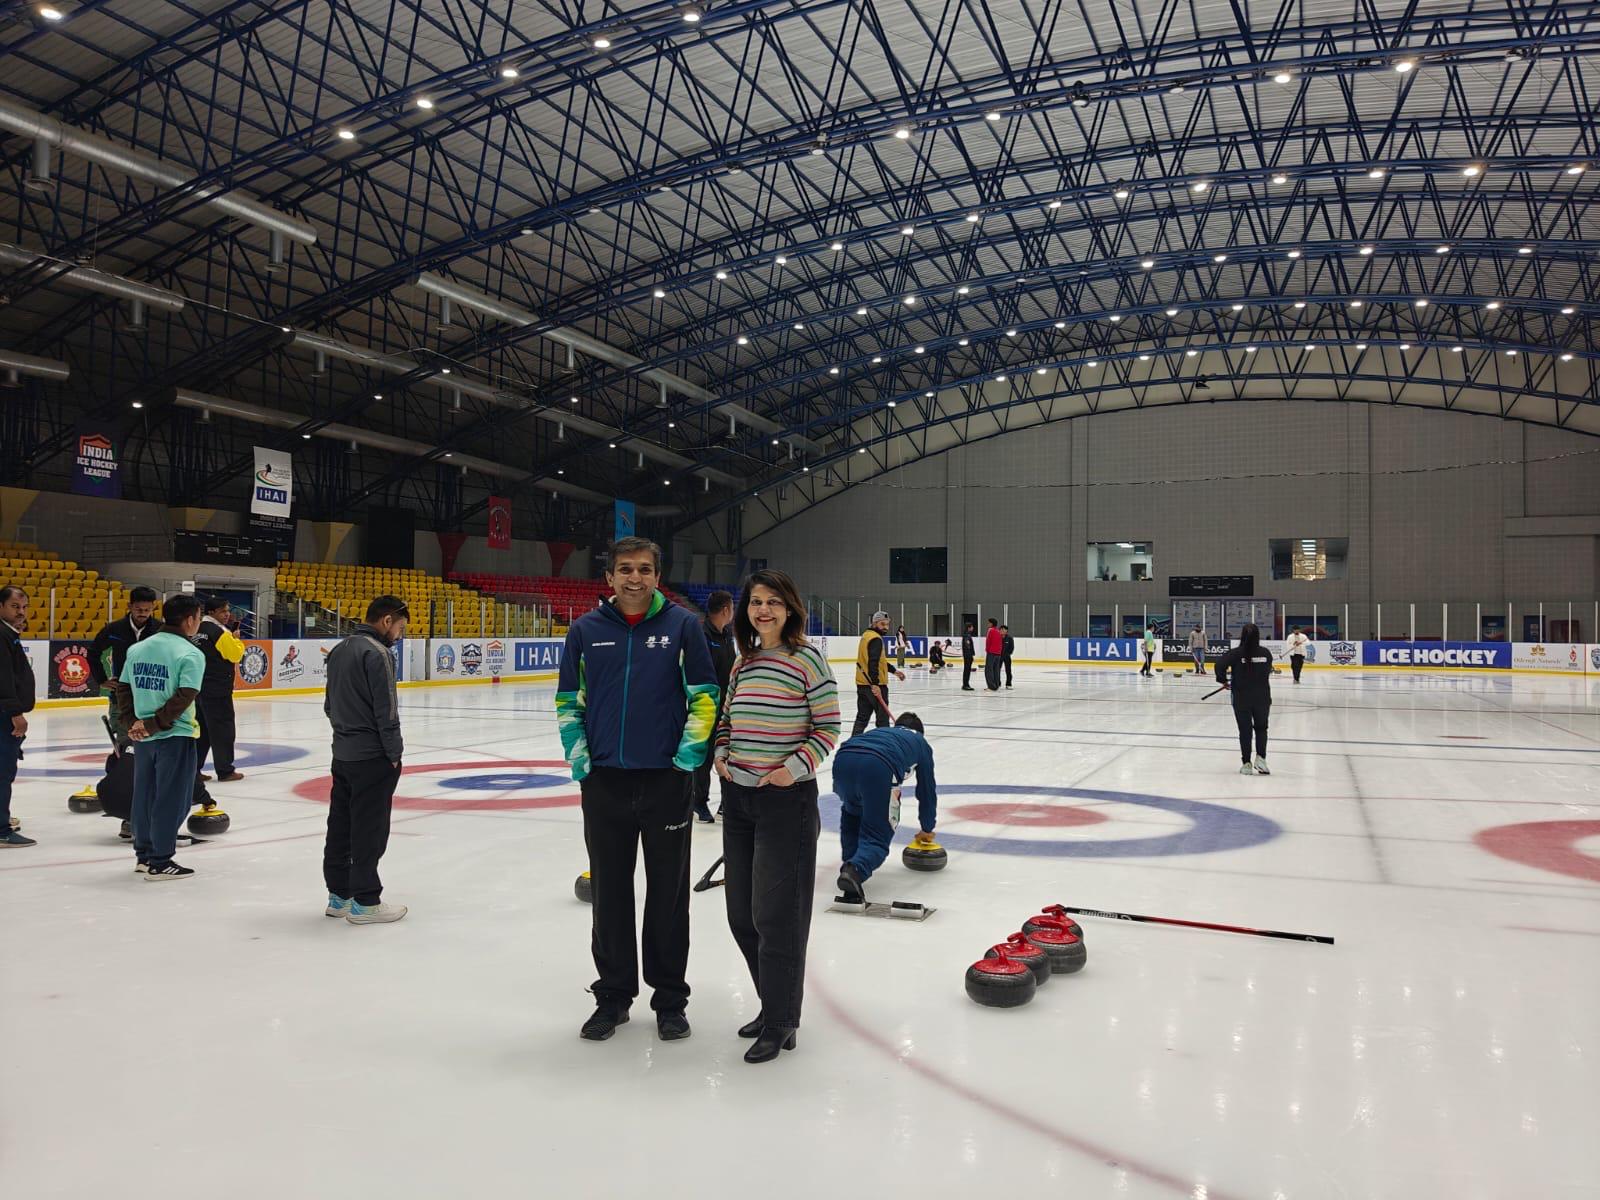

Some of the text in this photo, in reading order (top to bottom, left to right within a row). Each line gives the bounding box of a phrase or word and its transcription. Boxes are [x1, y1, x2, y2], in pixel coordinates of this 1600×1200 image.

[83, 445, 113, 460] INDIA
[77, 456, 118, 470] ICE HOCKEY
[84, 467, 111, 478] LEAGUE
[260, 490, 284, 502] IHAI
[888, 640, 923, 655] HAI
[1076, 642, 1130, 657] IHAI
[520, 647, 559, 666] IHAI
[1380, 648, 1497, 665] ICE HOCKEY
